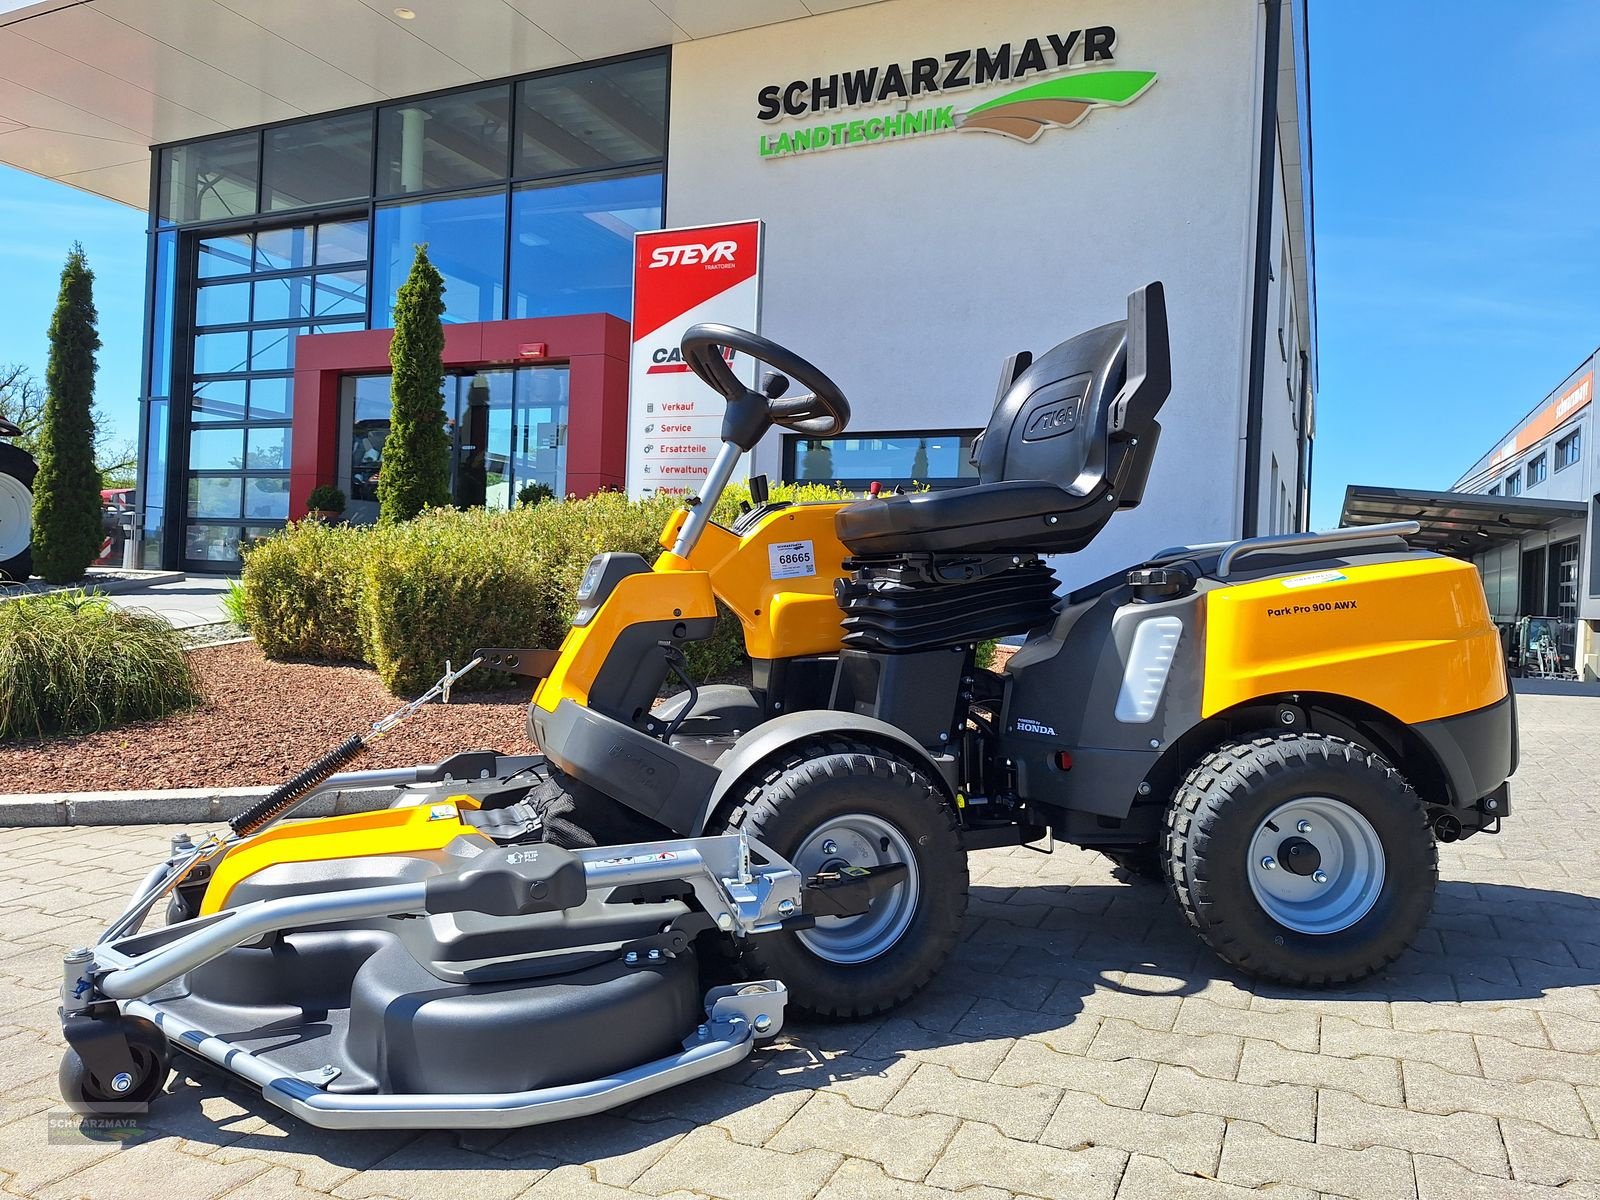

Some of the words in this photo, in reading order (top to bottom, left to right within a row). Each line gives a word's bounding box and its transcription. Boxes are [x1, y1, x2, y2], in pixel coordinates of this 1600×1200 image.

[757, 25, 1116, 121] SCHWARZMAYR
[760, 105, 955, 157] LANDTECHNIK
[649, 241, 737, 268] STEYR
[652, 347, 685, 364] CA
[662, 402, 695, 412] Verkauf
[660, 424, 692, 433] Service
[660, 444, 707, 453] Ersatzteile
[659, 465, 708, 476] Verwaltung
[780, 553, 810, 564] 68665
[1267, 607, 1292, 617] Park
[1294, 605, 1311, 614] Pro
[1312, 602, 1332, 612] 900
[1334, 600, 1358, 610] AWX
[1017, 723, 1055, 735] HONDA
